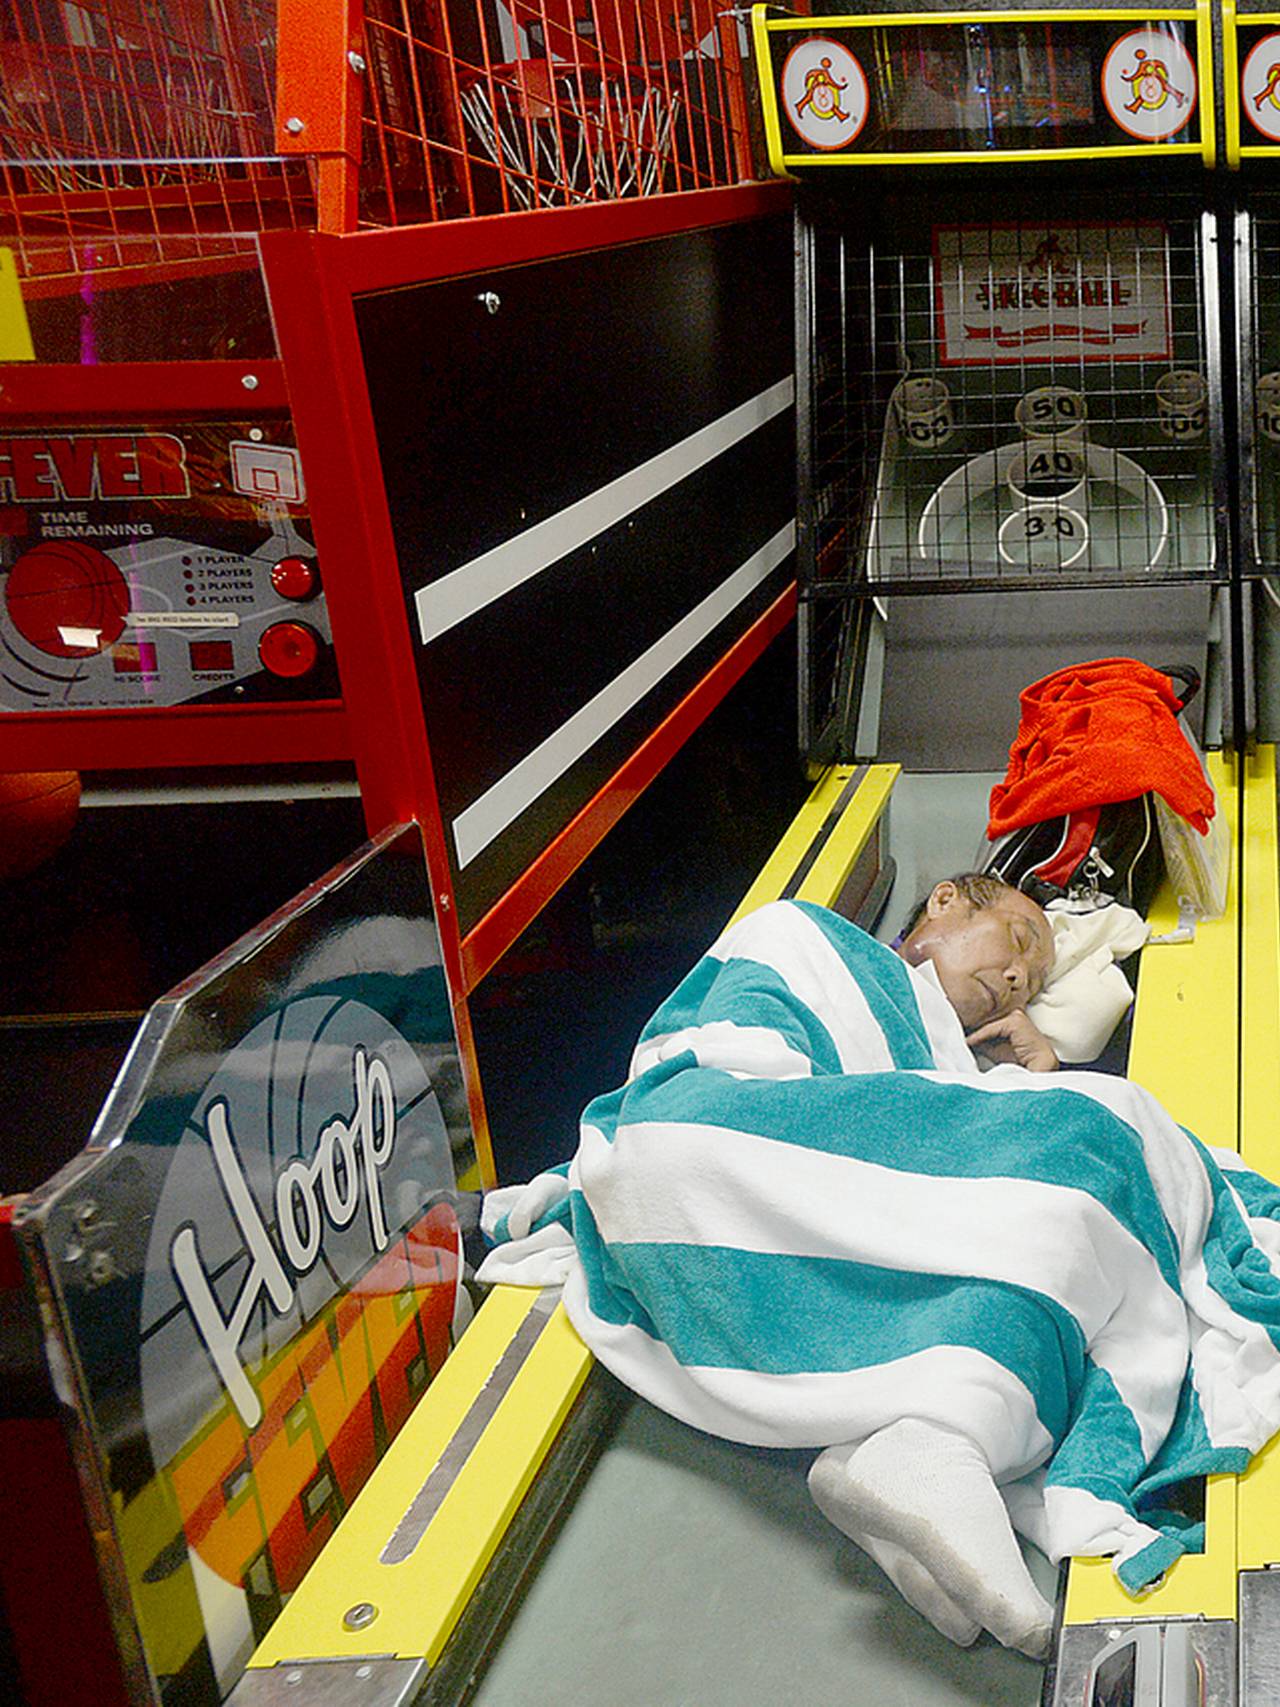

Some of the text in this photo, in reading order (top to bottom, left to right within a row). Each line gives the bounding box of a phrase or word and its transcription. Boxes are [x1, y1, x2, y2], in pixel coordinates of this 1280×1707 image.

[1032, 397, 1076, 419] 50
[0, 433, 191, 502] EVER
[1029, 451, 1074, 473] 40
[40, 511, 89, 523] TIME
[1025, 516, 1074, 537] 30
[42, 523, 154, 537] REMAINING
[169, 1044, 396, 1430] Hoop
